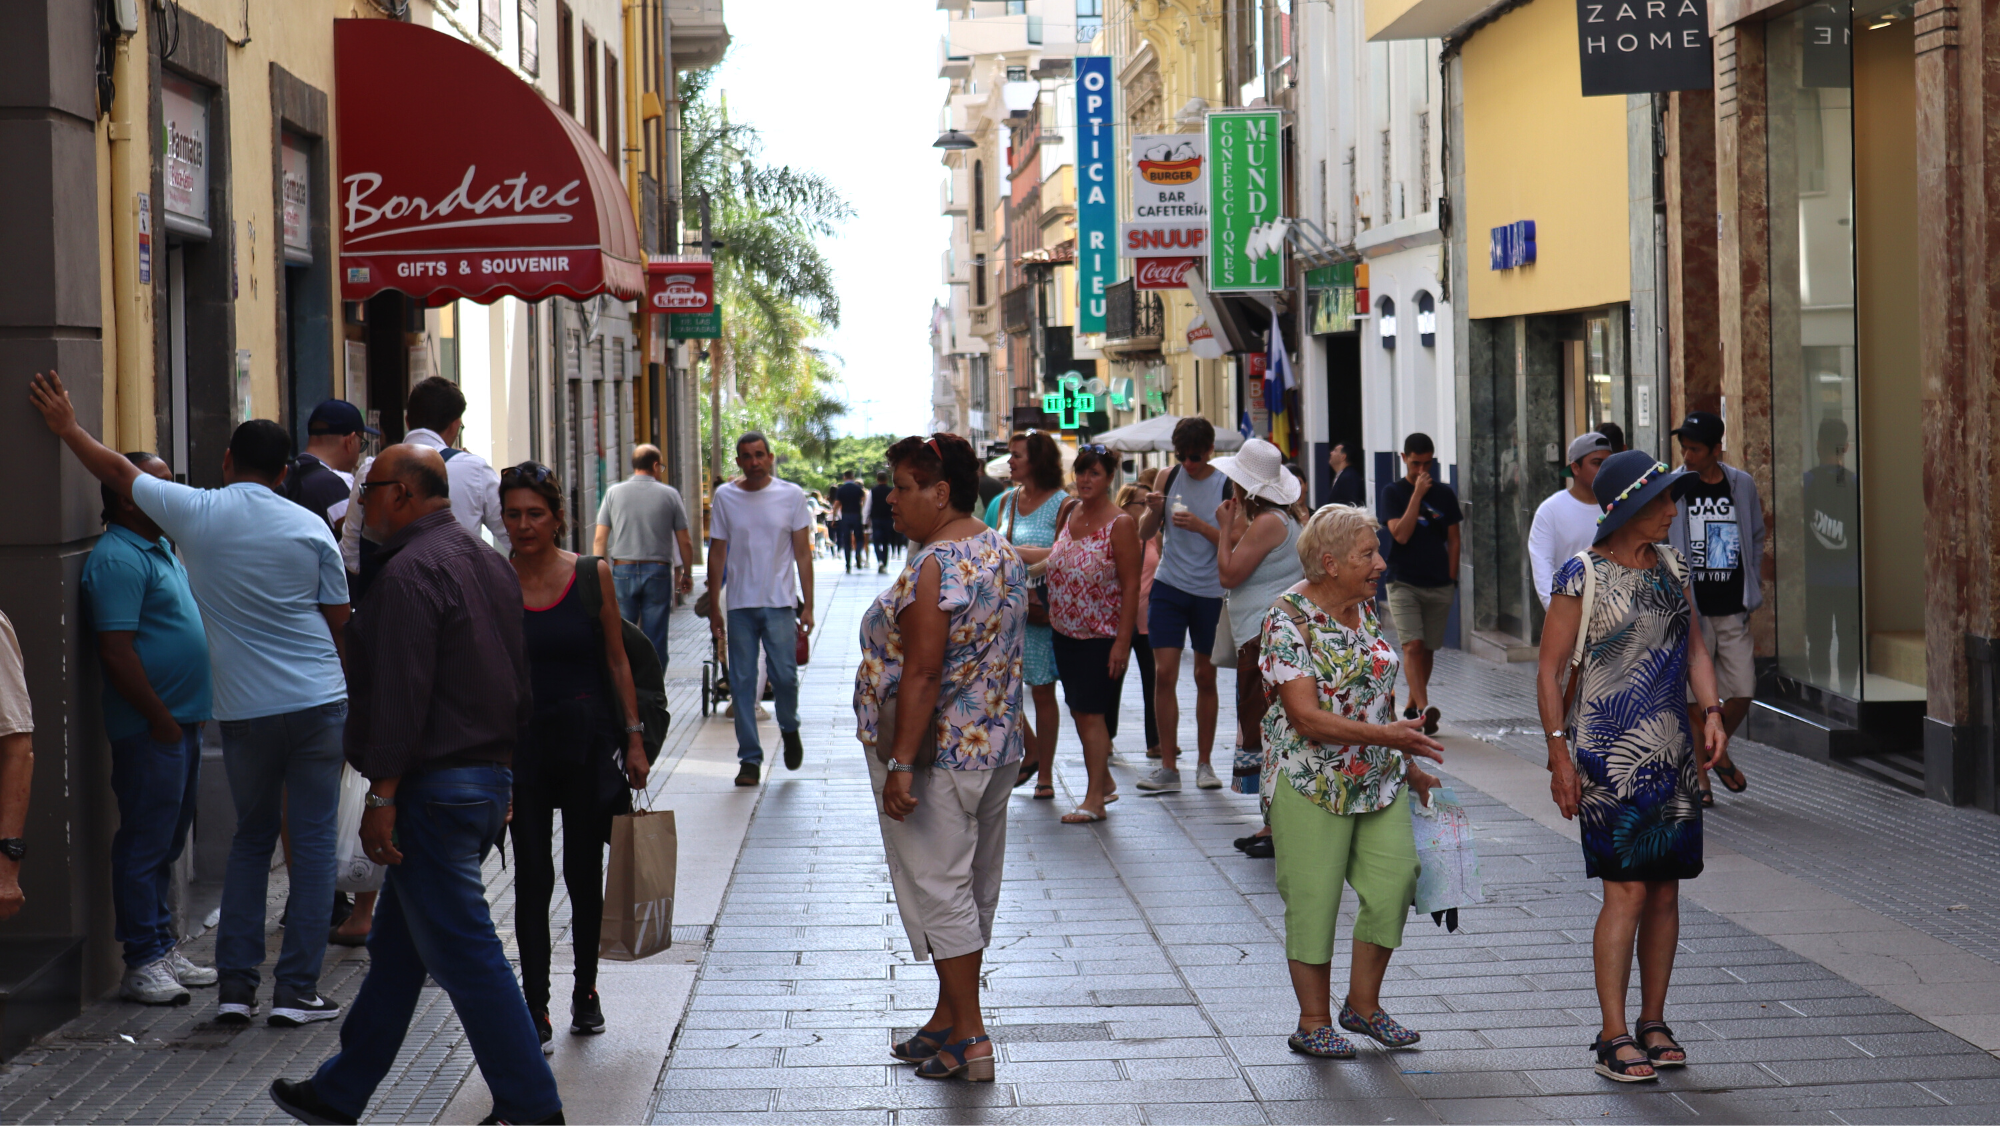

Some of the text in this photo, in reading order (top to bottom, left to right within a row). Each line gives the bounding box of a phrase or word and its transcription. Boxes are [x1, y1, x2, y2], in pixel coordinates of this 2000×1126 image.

[1587, 0, 1698, 22] ZARA
[1587, 30, 1701, 54] HOME
[1150, 171, 1193, 181] BURGER
[343, 164, 581, 232] Bordatec
[1083, 72, 1107, 317] OPTICA RIEU
[1159, 191, 1186, 202] BAR
[1221, 121, 1235, 284] CONFECCIONES
[1245, 120, 1268, 284] MUNDIL
[1128, 228, 1208, 249] SNUUP
[397, 257, 570, 278] GIFTS & SOUVENIR
[658, 295, 705, 306] Ricardo
[1048, 397, 1090, 411] 10:41
[1708, 570, 1732, 582] YORK
